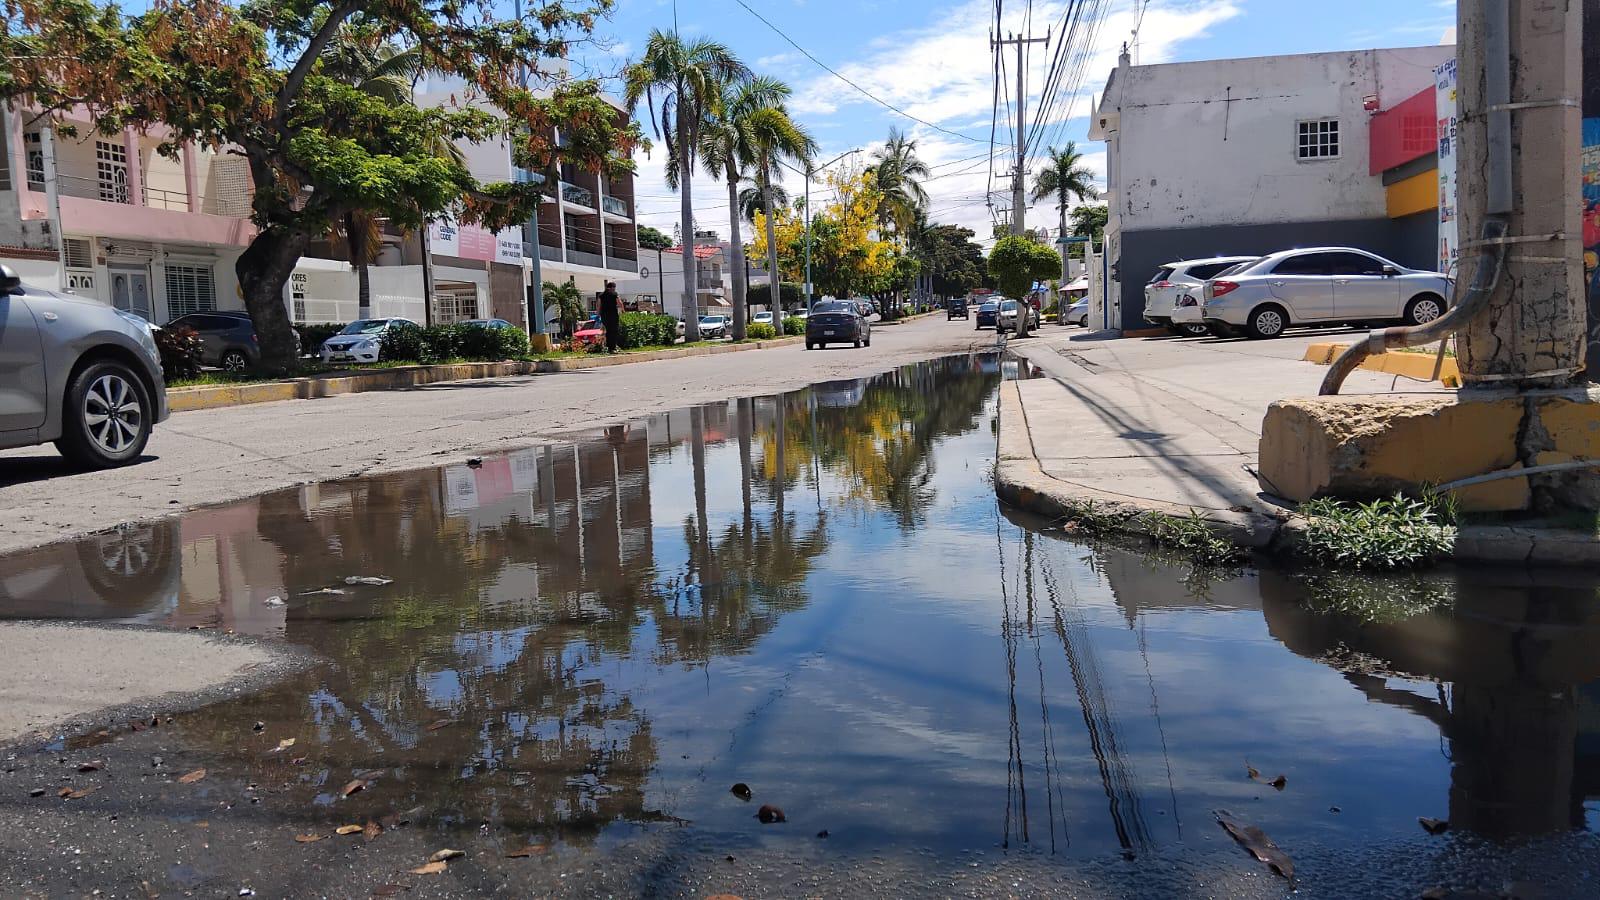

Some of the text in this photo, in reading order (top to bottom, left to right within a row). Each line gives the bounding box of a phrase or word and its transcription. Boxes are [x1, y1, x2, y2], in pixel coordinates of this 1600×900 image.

[440, 225, 456, 235] GENERAL
[440, 233, 452, 241] CODE
[291, 273, 307, 282] ORES
